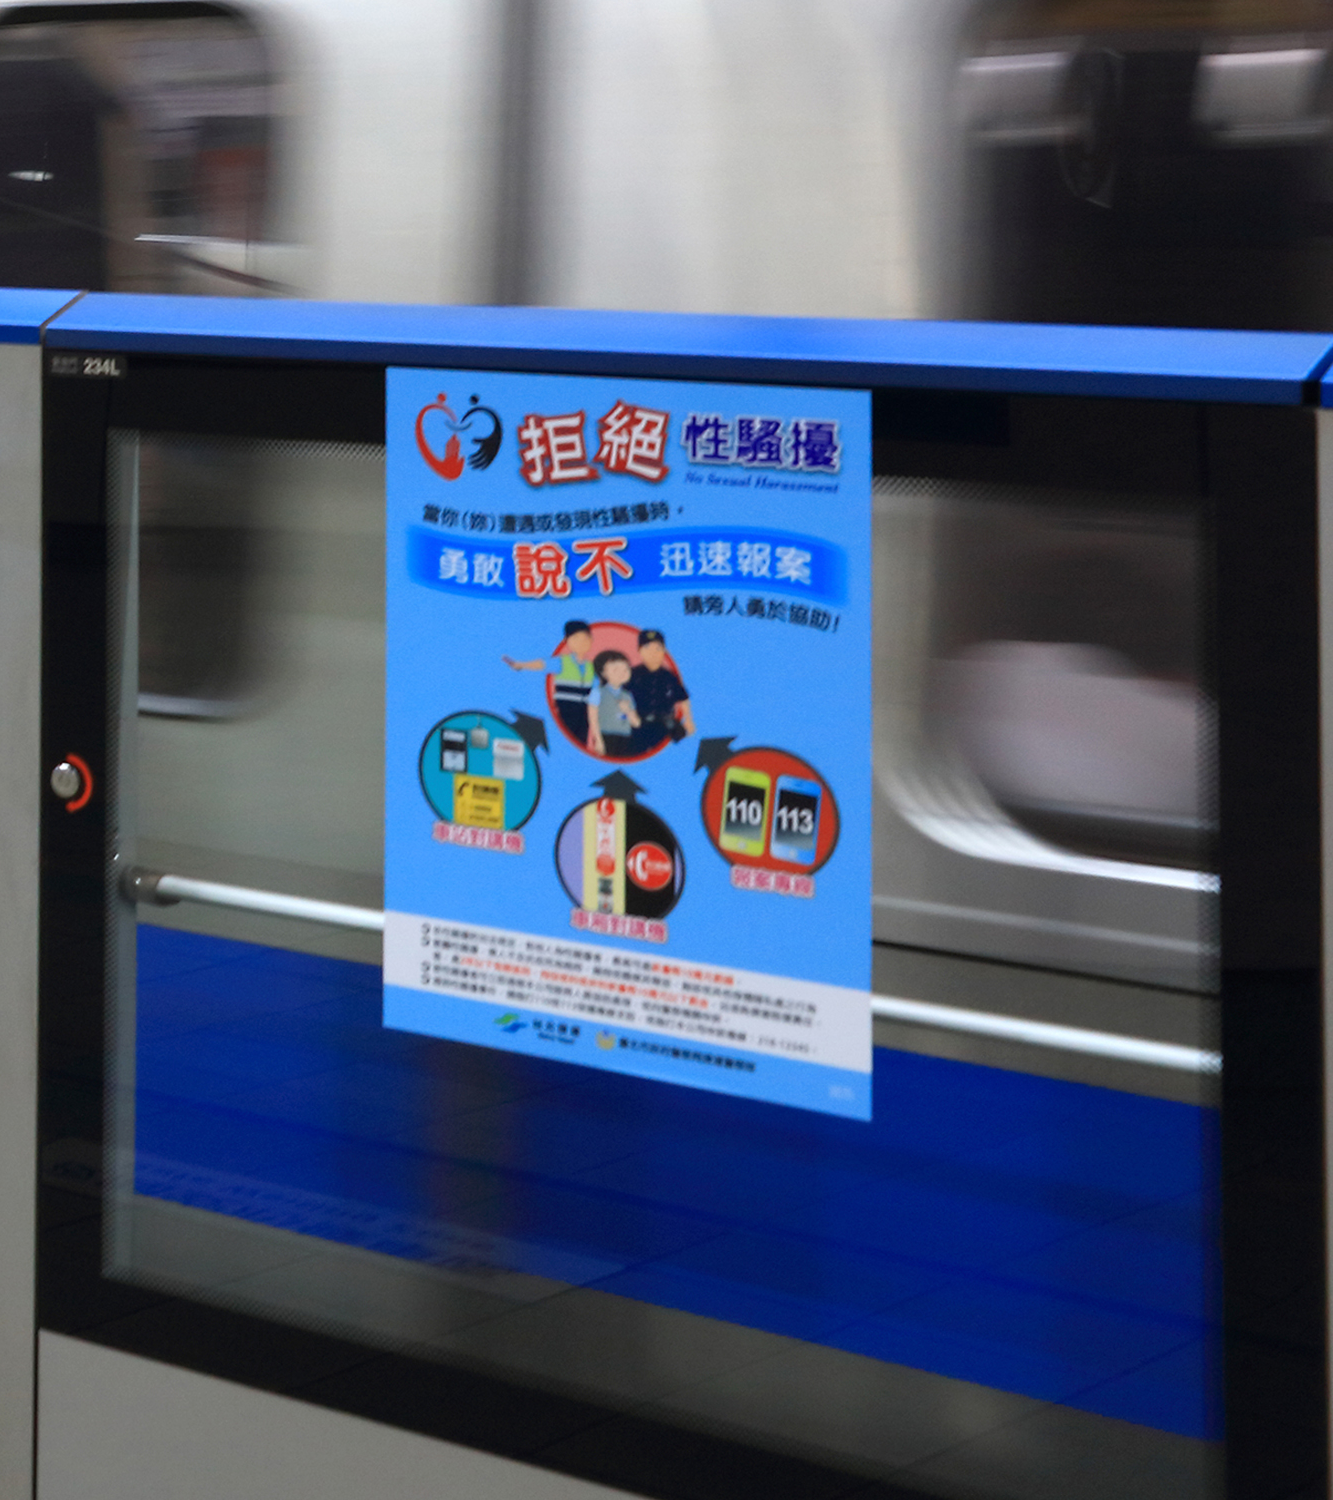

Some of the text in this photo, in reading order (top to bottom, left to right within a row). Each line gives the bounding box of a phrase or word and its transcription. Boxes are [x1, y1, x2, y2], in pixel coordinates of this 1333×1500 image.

[83, 357, 121, 376] 234L
[518, 401, 669, 485] 拒絕
[683, 413, 841, 473] 性騷擾
[685, 471, 702, 485] No
[707, 473, 751, 488] Sexual
[438, 547, 504, 588] 勇敢
[513, 537, 633, 598] 說不
[660, 541, 811, 586] 迅速報案
[726, 797, 763, 825] 110
[777, 806, 815, 835] 113
